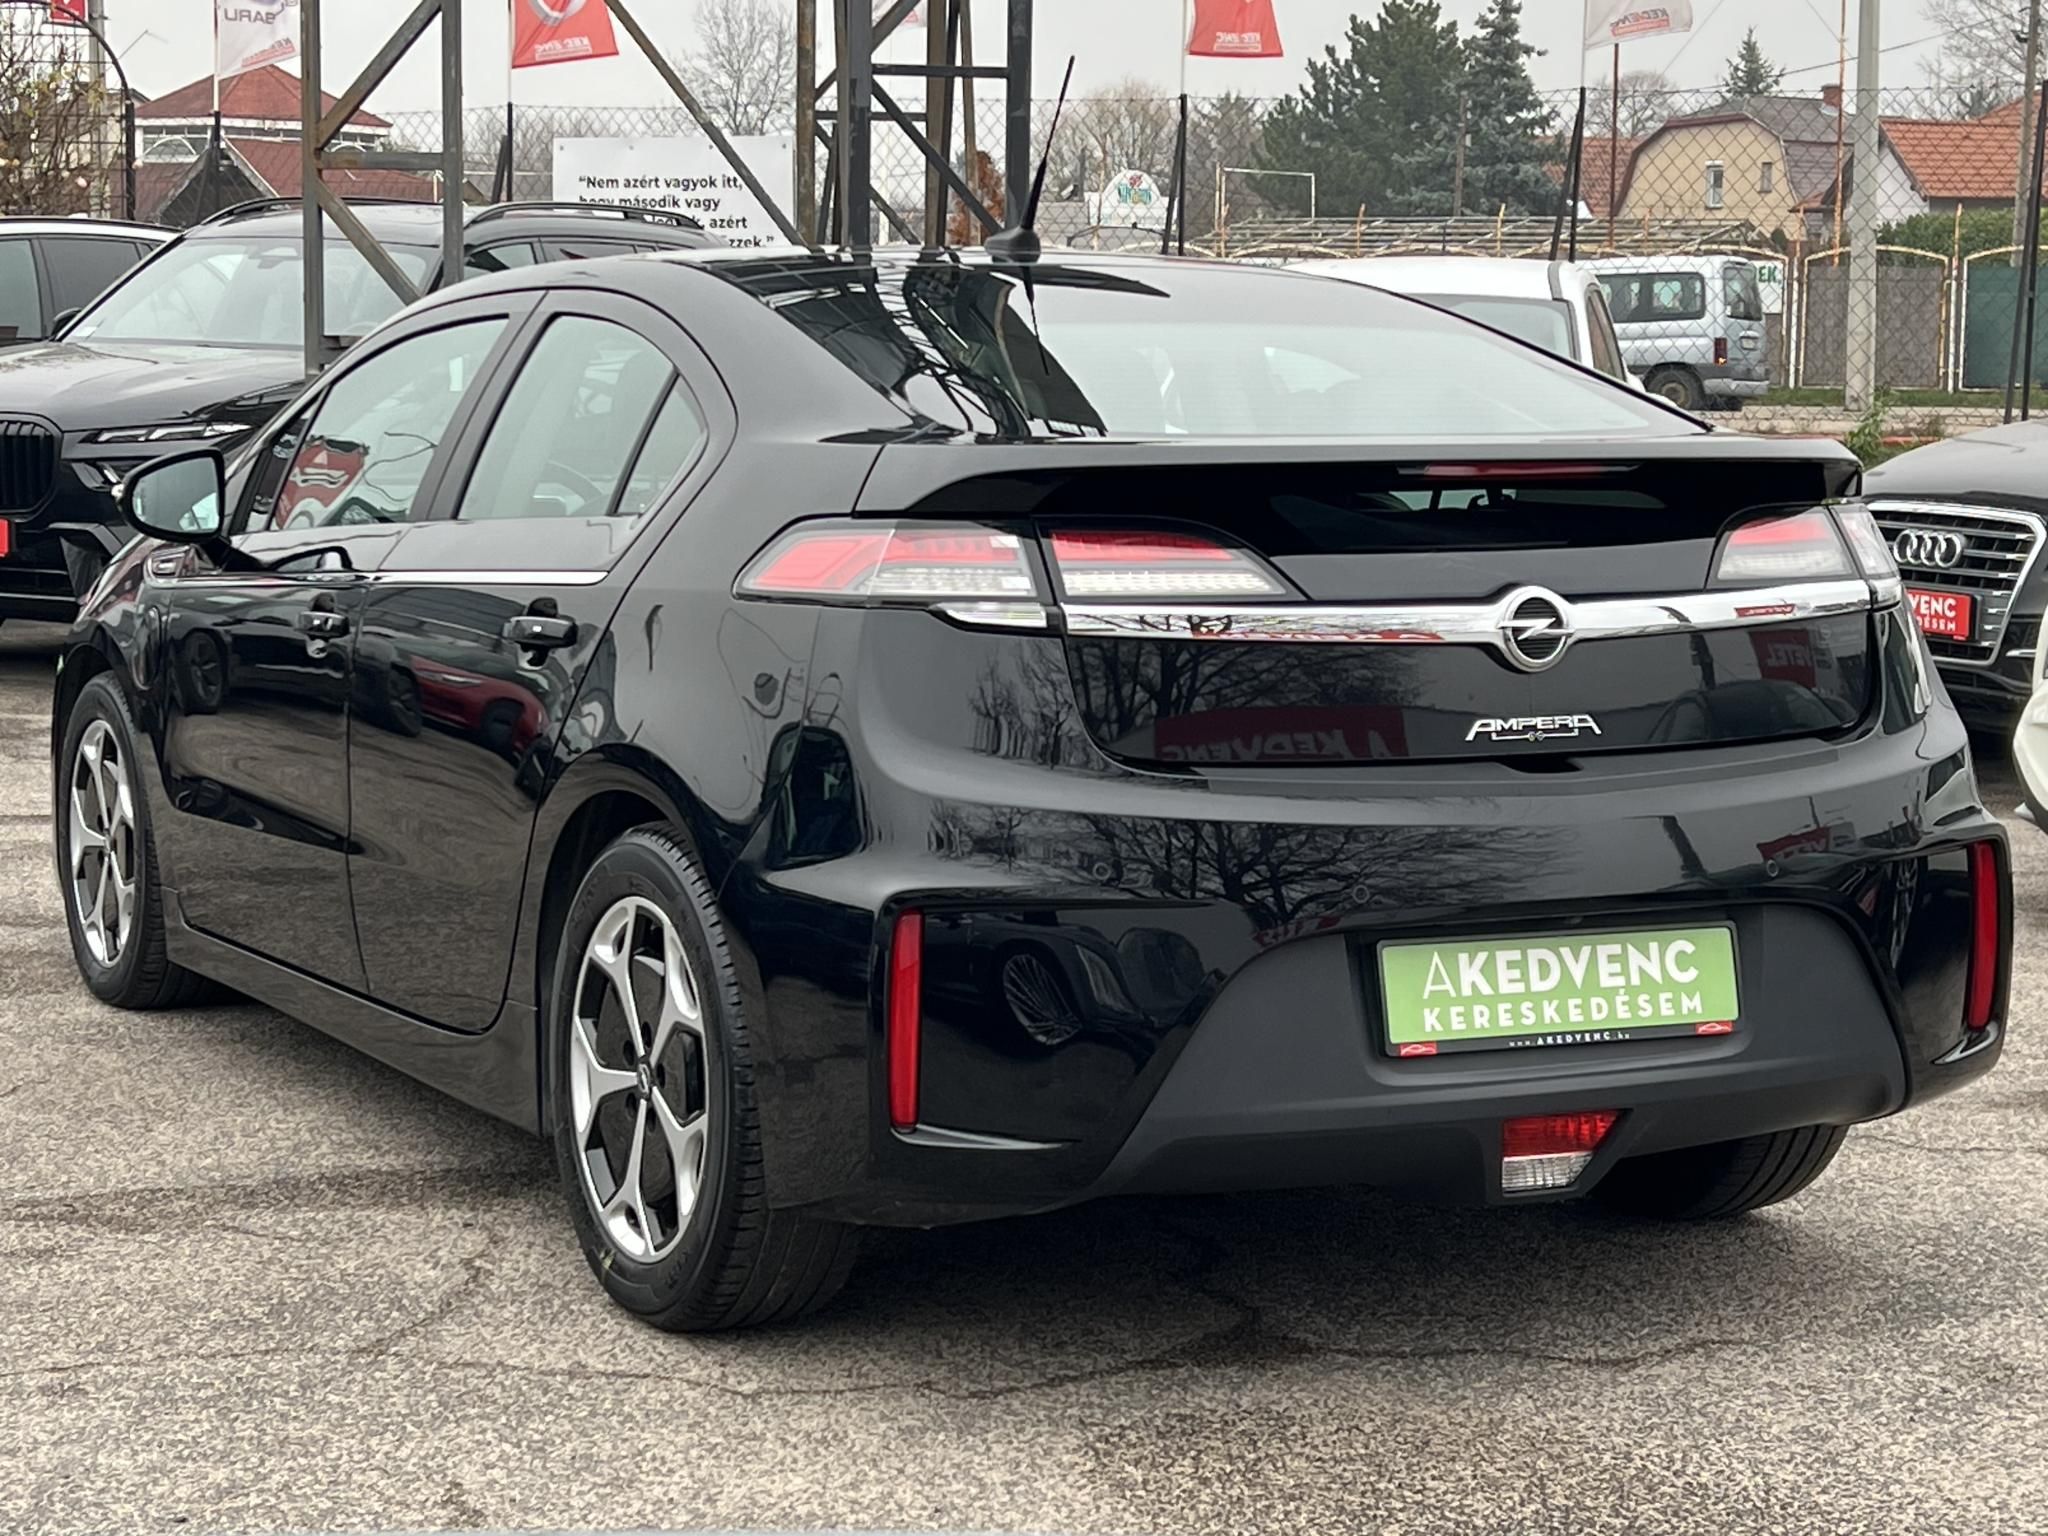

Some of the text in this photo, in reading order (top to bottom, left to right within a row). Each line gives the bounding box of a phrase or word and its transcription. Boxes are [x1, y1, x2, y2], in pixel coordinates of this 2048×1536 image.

[623, 175, 660, 189] azért
[663, 176, 718, 191] vagyok
[721, 174, 744, 190] itt,
[619, 193, 681, 208] második
[685, 197, 721, 212] vagy
[708, 215, 748, 229] azért
[1908, 593, 1957, 618] VENC
[1464, 714, 1603, 742] AMPERA
[1422, 988, 1703, 1033] KERESKEDÉSEM
